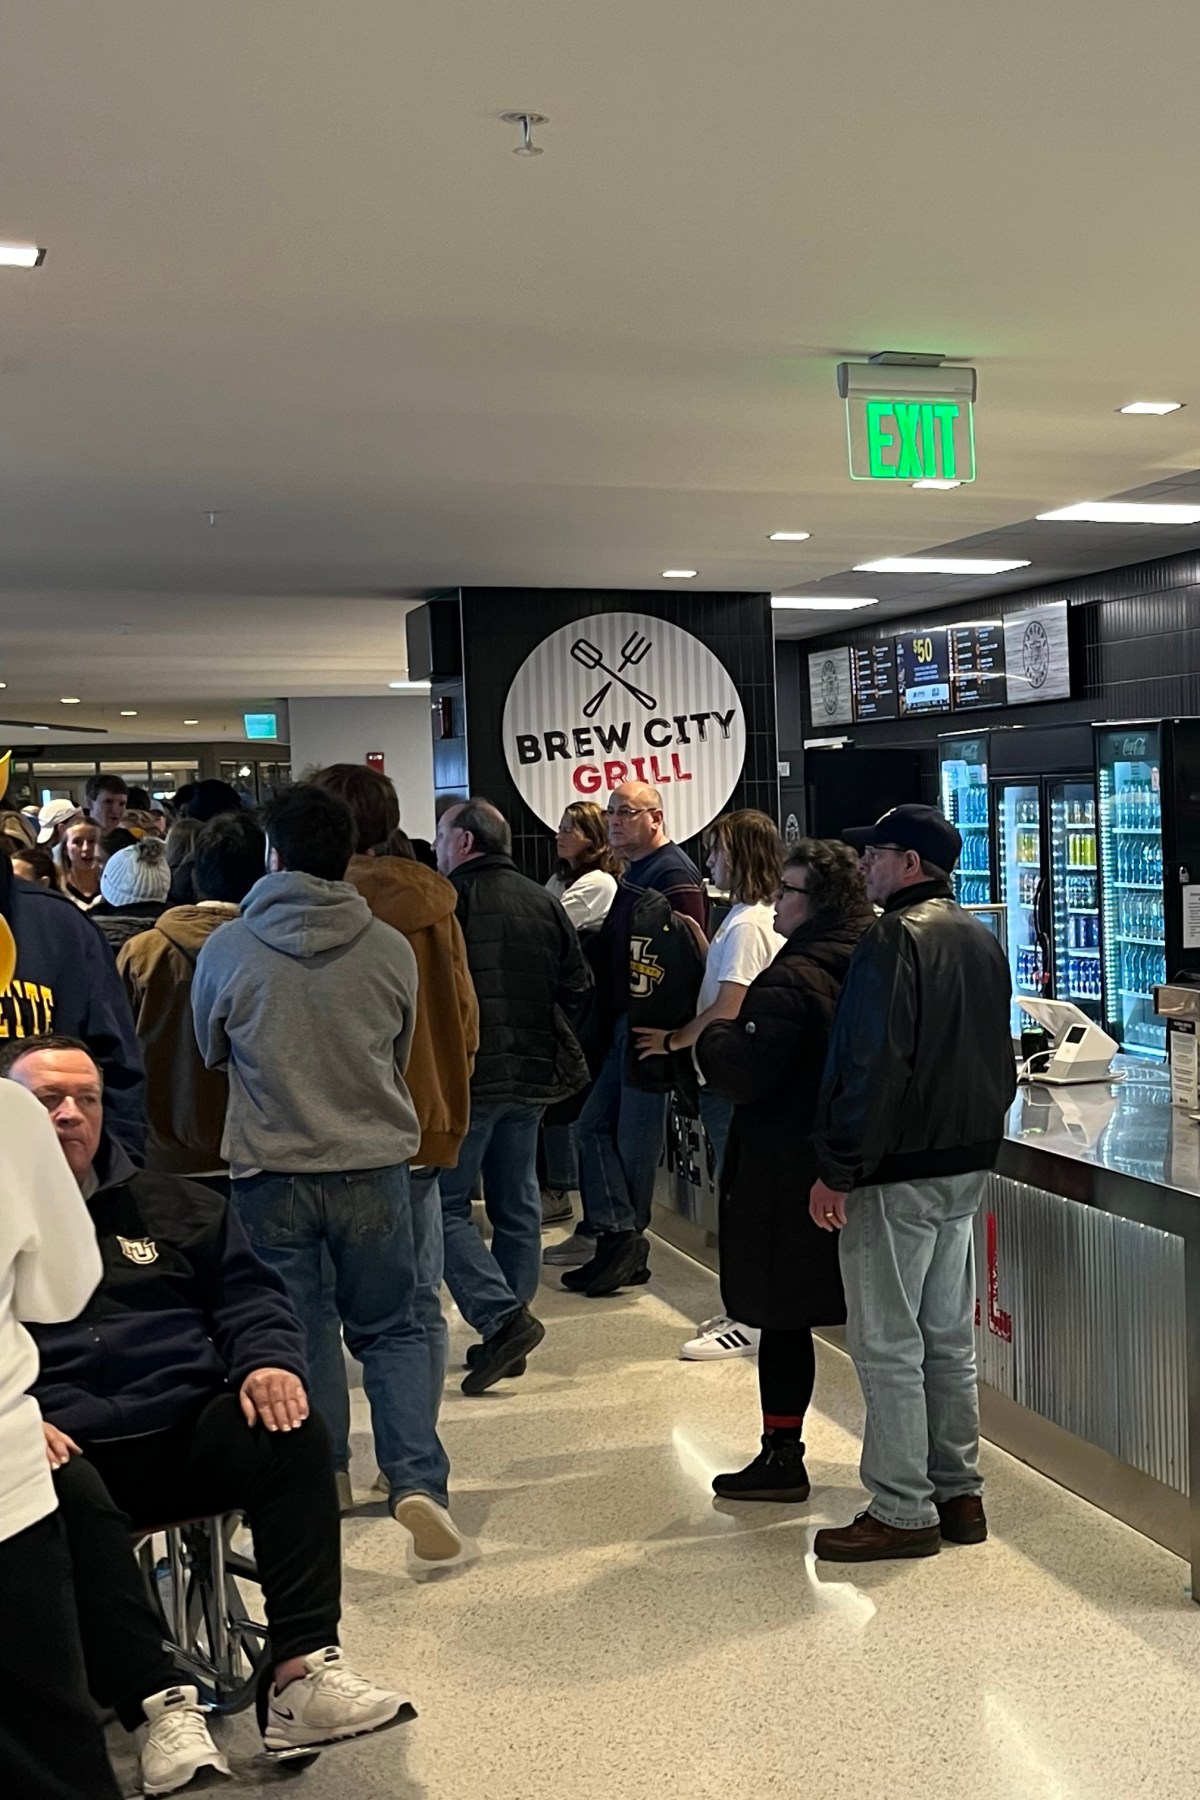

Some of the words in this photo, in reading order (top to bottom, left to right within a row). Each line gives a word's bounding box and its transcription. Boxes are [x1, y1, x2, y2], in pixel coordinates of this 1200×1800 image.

[866, 402, 959, 478] EXIT
[912, 637, 933, 663] $50
[515, 721, 631, 765] BREW
[643, 709, 737, 748] CITY
[572, 753, 693, 794] GRILL
